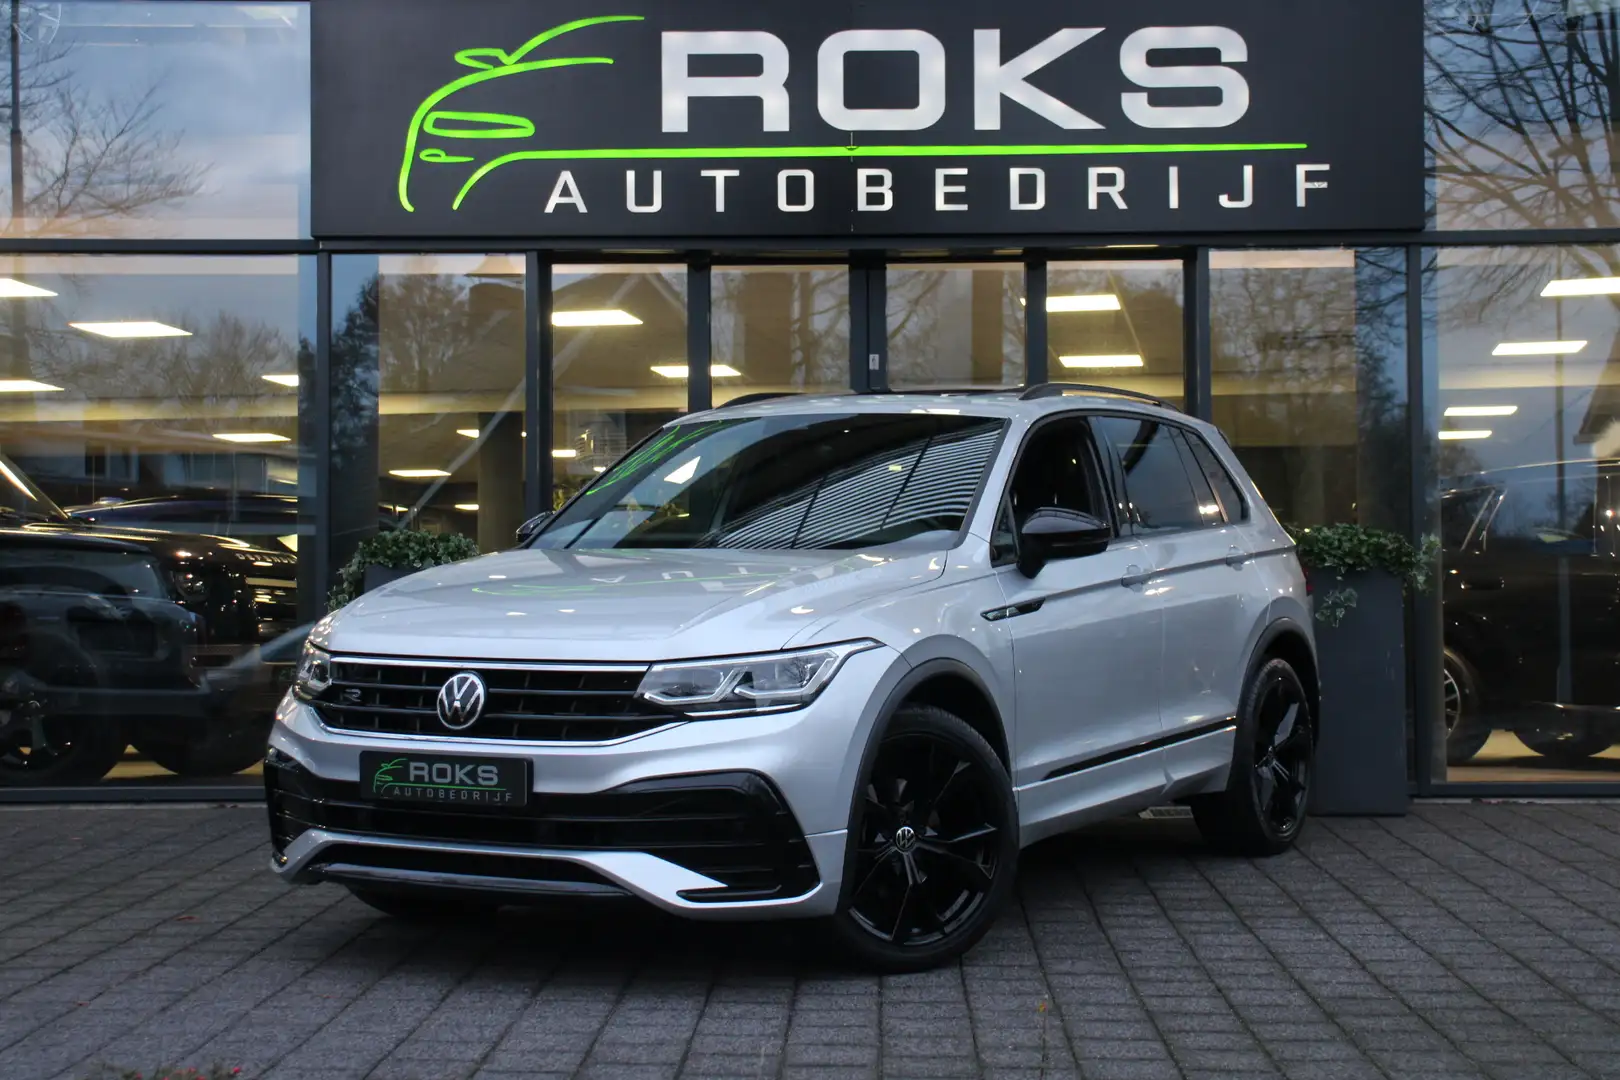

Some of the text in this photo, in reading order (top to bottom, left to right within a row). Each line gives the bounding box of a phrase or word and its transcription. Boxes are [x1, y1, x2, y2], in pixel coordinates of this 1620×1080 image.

[661, 25, 1250, 133] ROKS
[544, 164, 1331, 213] AUTOBEDRIJF
[235, 552, 297, 565] DEFENDE
[437, 671, 485, 730] VW
[409, 761, 499, 786] ROKS
[393, 787, 513, 802] AUTOBEDRIJF
